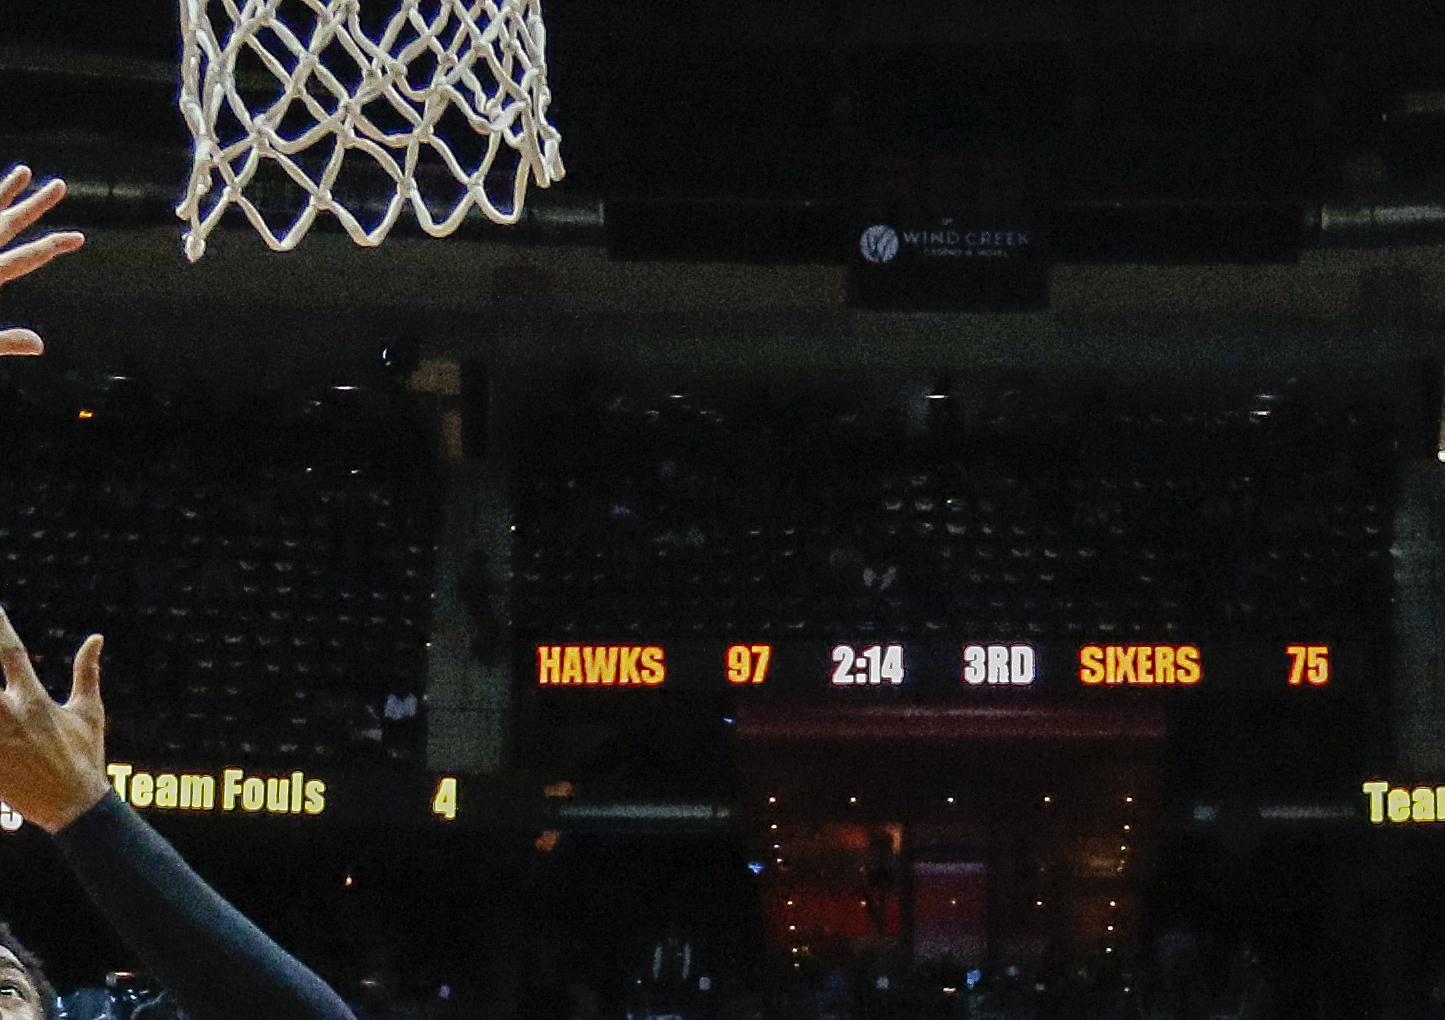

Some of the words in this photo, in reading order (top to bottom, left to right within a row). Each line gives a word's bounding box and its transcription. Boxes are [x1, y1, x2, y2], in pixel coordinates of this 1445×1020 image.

[903, 231, 960, 245] WIND
[965, 231, 1029, 246] CREEK
[538, 645, 666, 686] HAWKS
[727, 645, 770, 685] 97
[831, 645, 905, 686] 2:14
[963, 644, 1035, 685] 3RD
[1080, 645, 1201, 686] SIXERS
[1287, 645, 1330, 685] 75
[107, 763, 215, 811] Team
[224, 769, 327, 816] Fouls
[432, 778, 458, 820] 4
